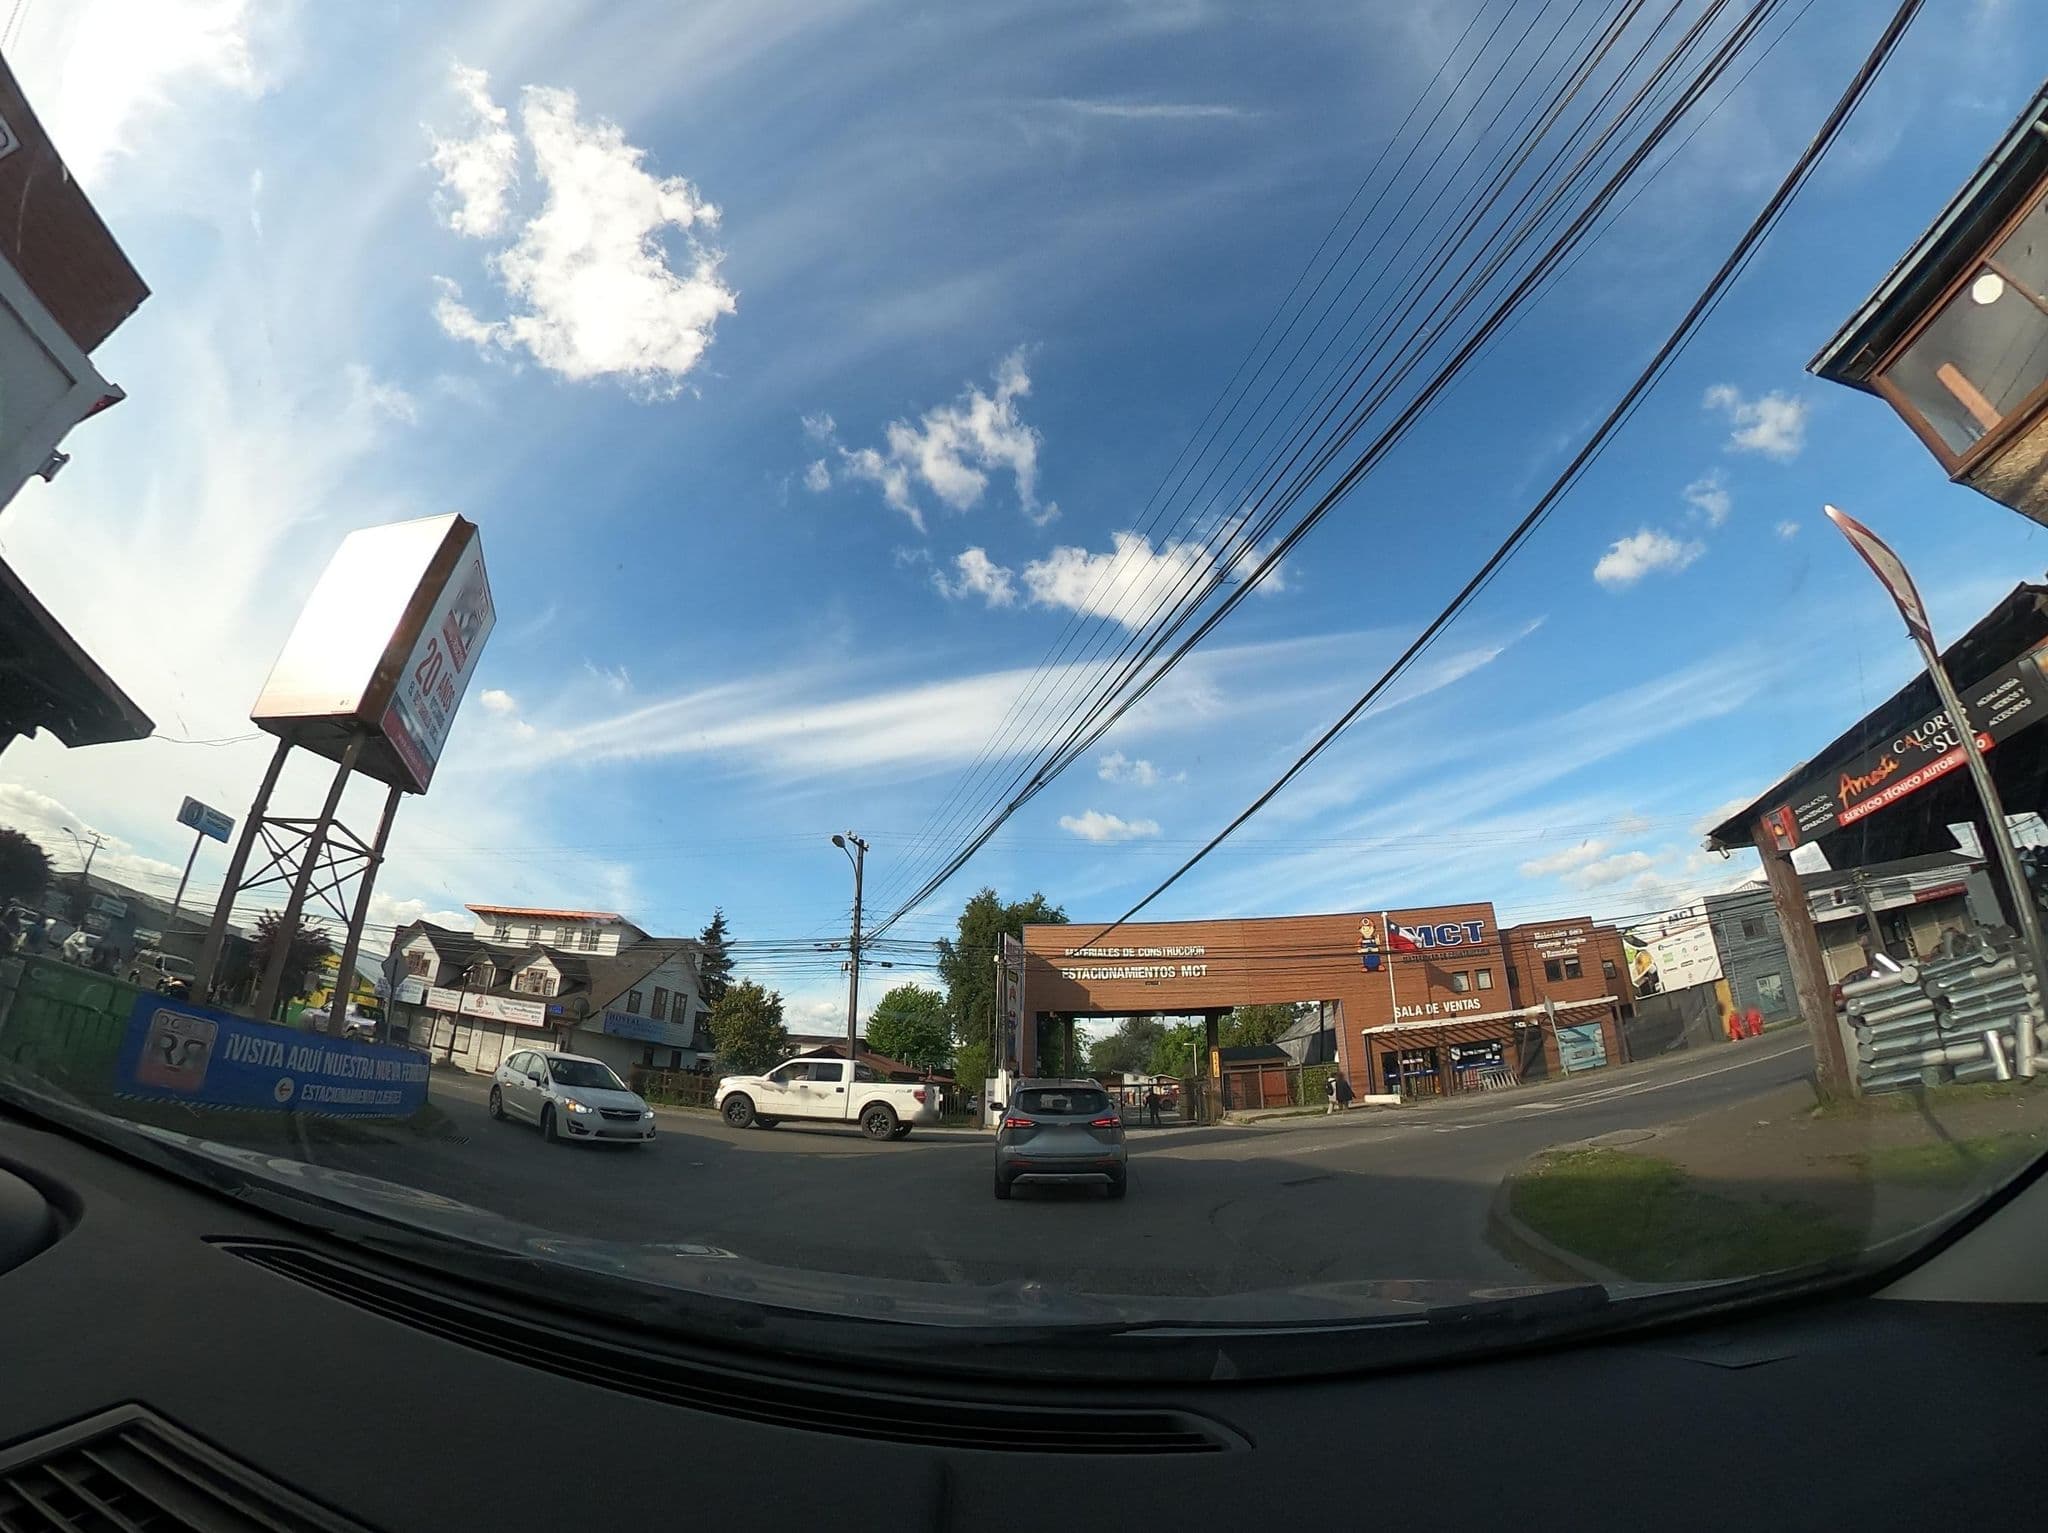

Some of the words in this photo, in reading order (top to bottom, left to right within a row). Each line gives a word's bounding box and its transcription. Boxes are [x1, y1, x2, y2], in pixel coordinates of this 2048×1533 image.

[415, 637, 442, 696] 20
[1844, 797, 1882, 822] SERVICIO
[1922, 738, 1985, 780] AUTORO
[1404, 920, 1485, 949] MCT
[1123, 948, 1135, 957] DE
[1062, 966, 1176, 980] ESTACIONAMIENTOS
[1181, 964, 1208, 977] MCT
[1395, 1006, 1423, 1018] SALA
[1426, 1003, 1440, 1015] DE
[1443, 998, 1481, 1012] VENTAS
[286, 1045, 325, 1073] AQUÍ
[323, 1051, 375, 1080] NUESTRA
